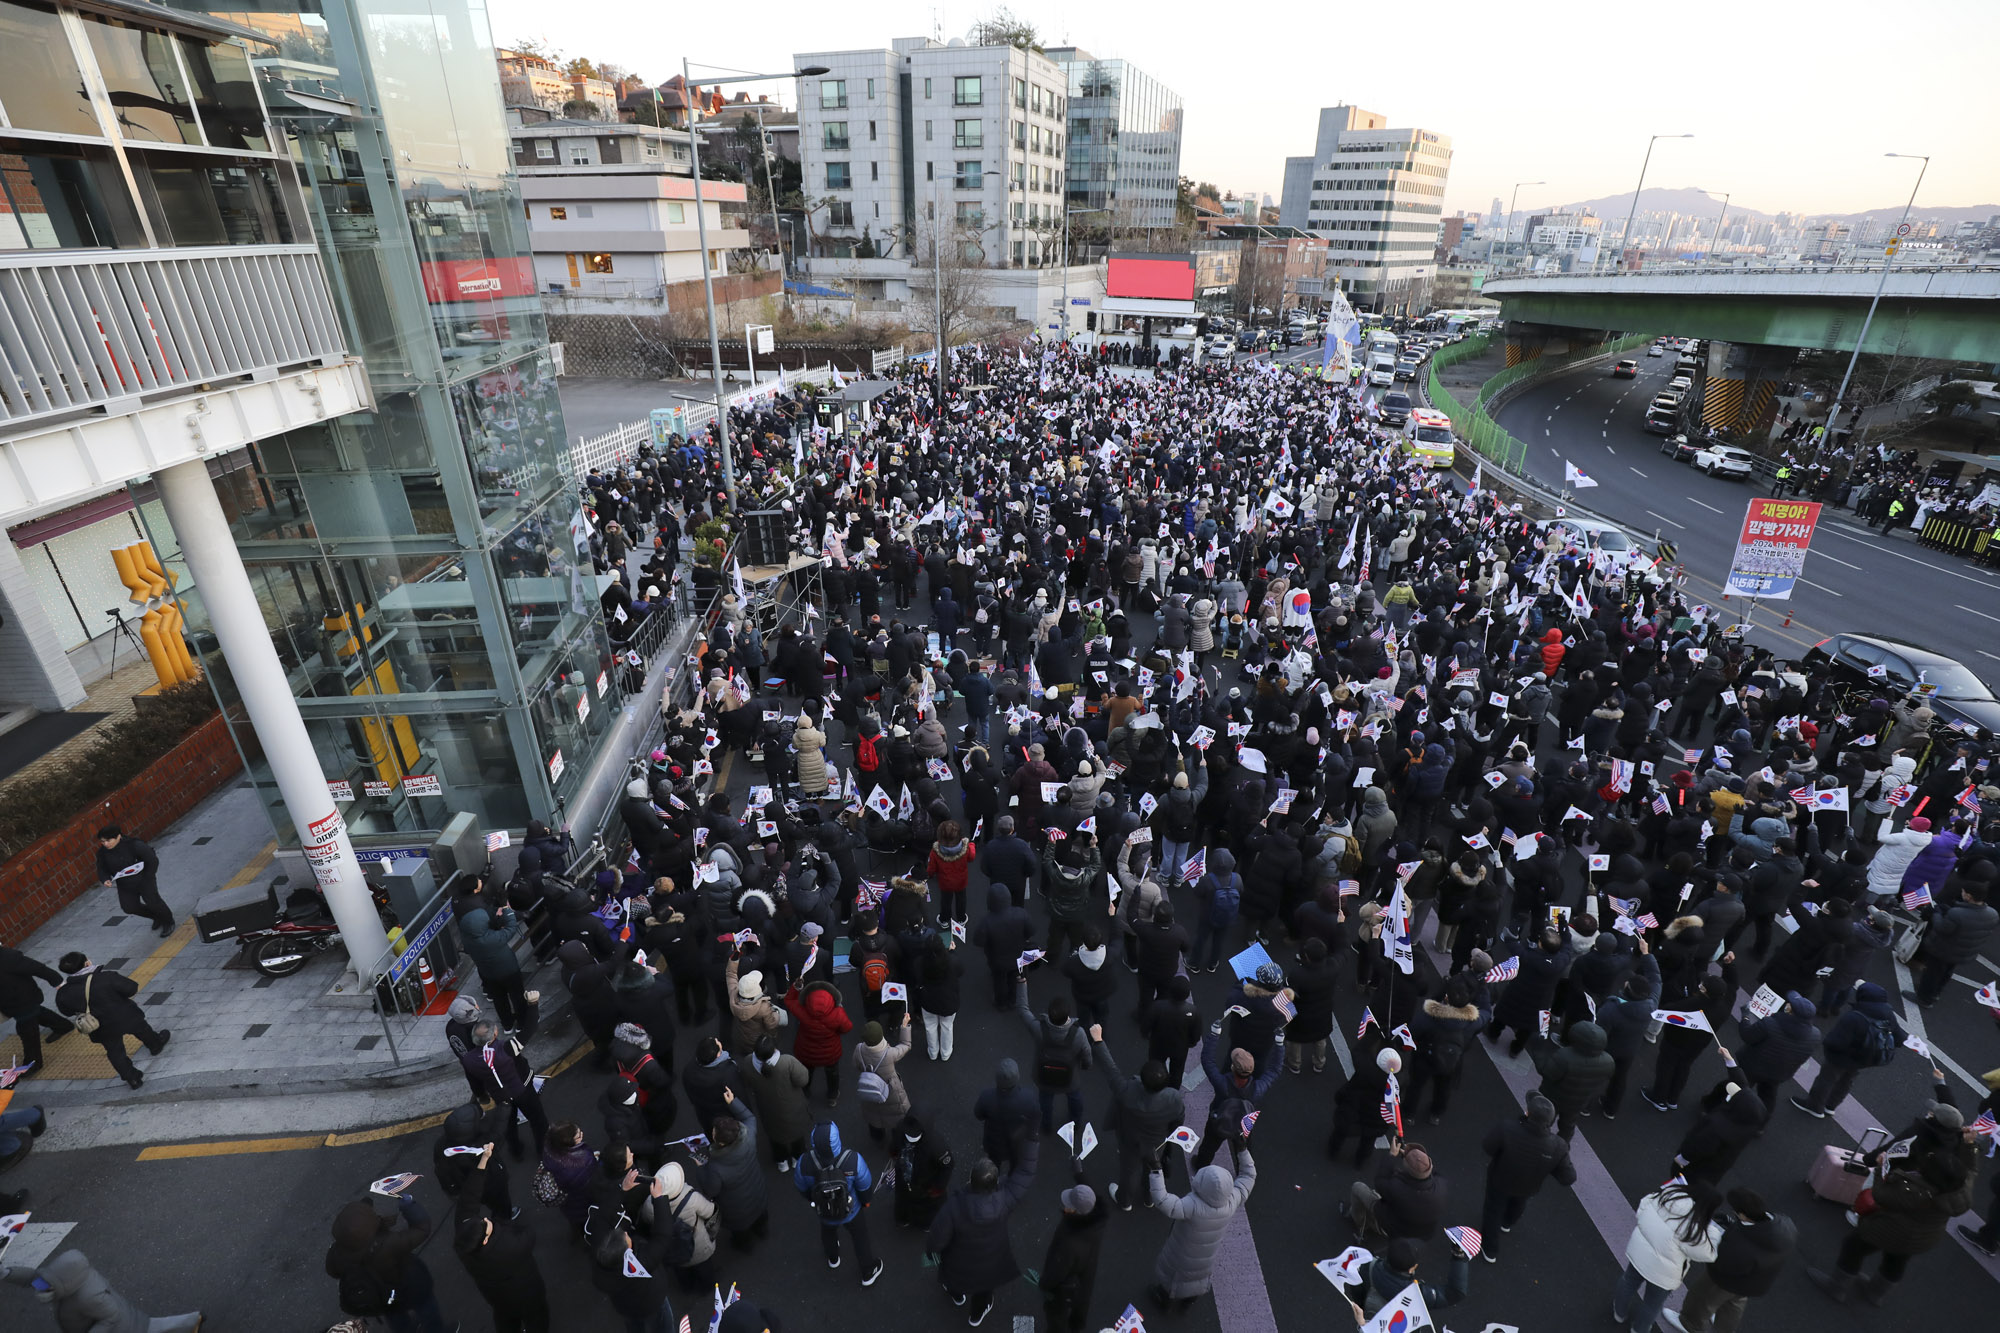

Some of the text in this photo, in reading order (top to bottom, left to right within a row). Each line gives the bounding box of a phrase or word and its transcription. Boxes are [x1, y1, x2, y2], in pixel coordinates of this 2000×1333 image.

[1761, 503, 1809, 519] 재명아!
[1748, 520, 1811, 538] 깜빵가자!
[404, 776, 437, 787] 탄핵반대
[407, 786, 426, 795] 이재명
[312, 811, 341, 836] 탄핵반
[316, 827, 339, 844] 이재명
[355, 850, 410, 861] OLICE LINE
[404, 914, 444, 965] POLICE LINE
